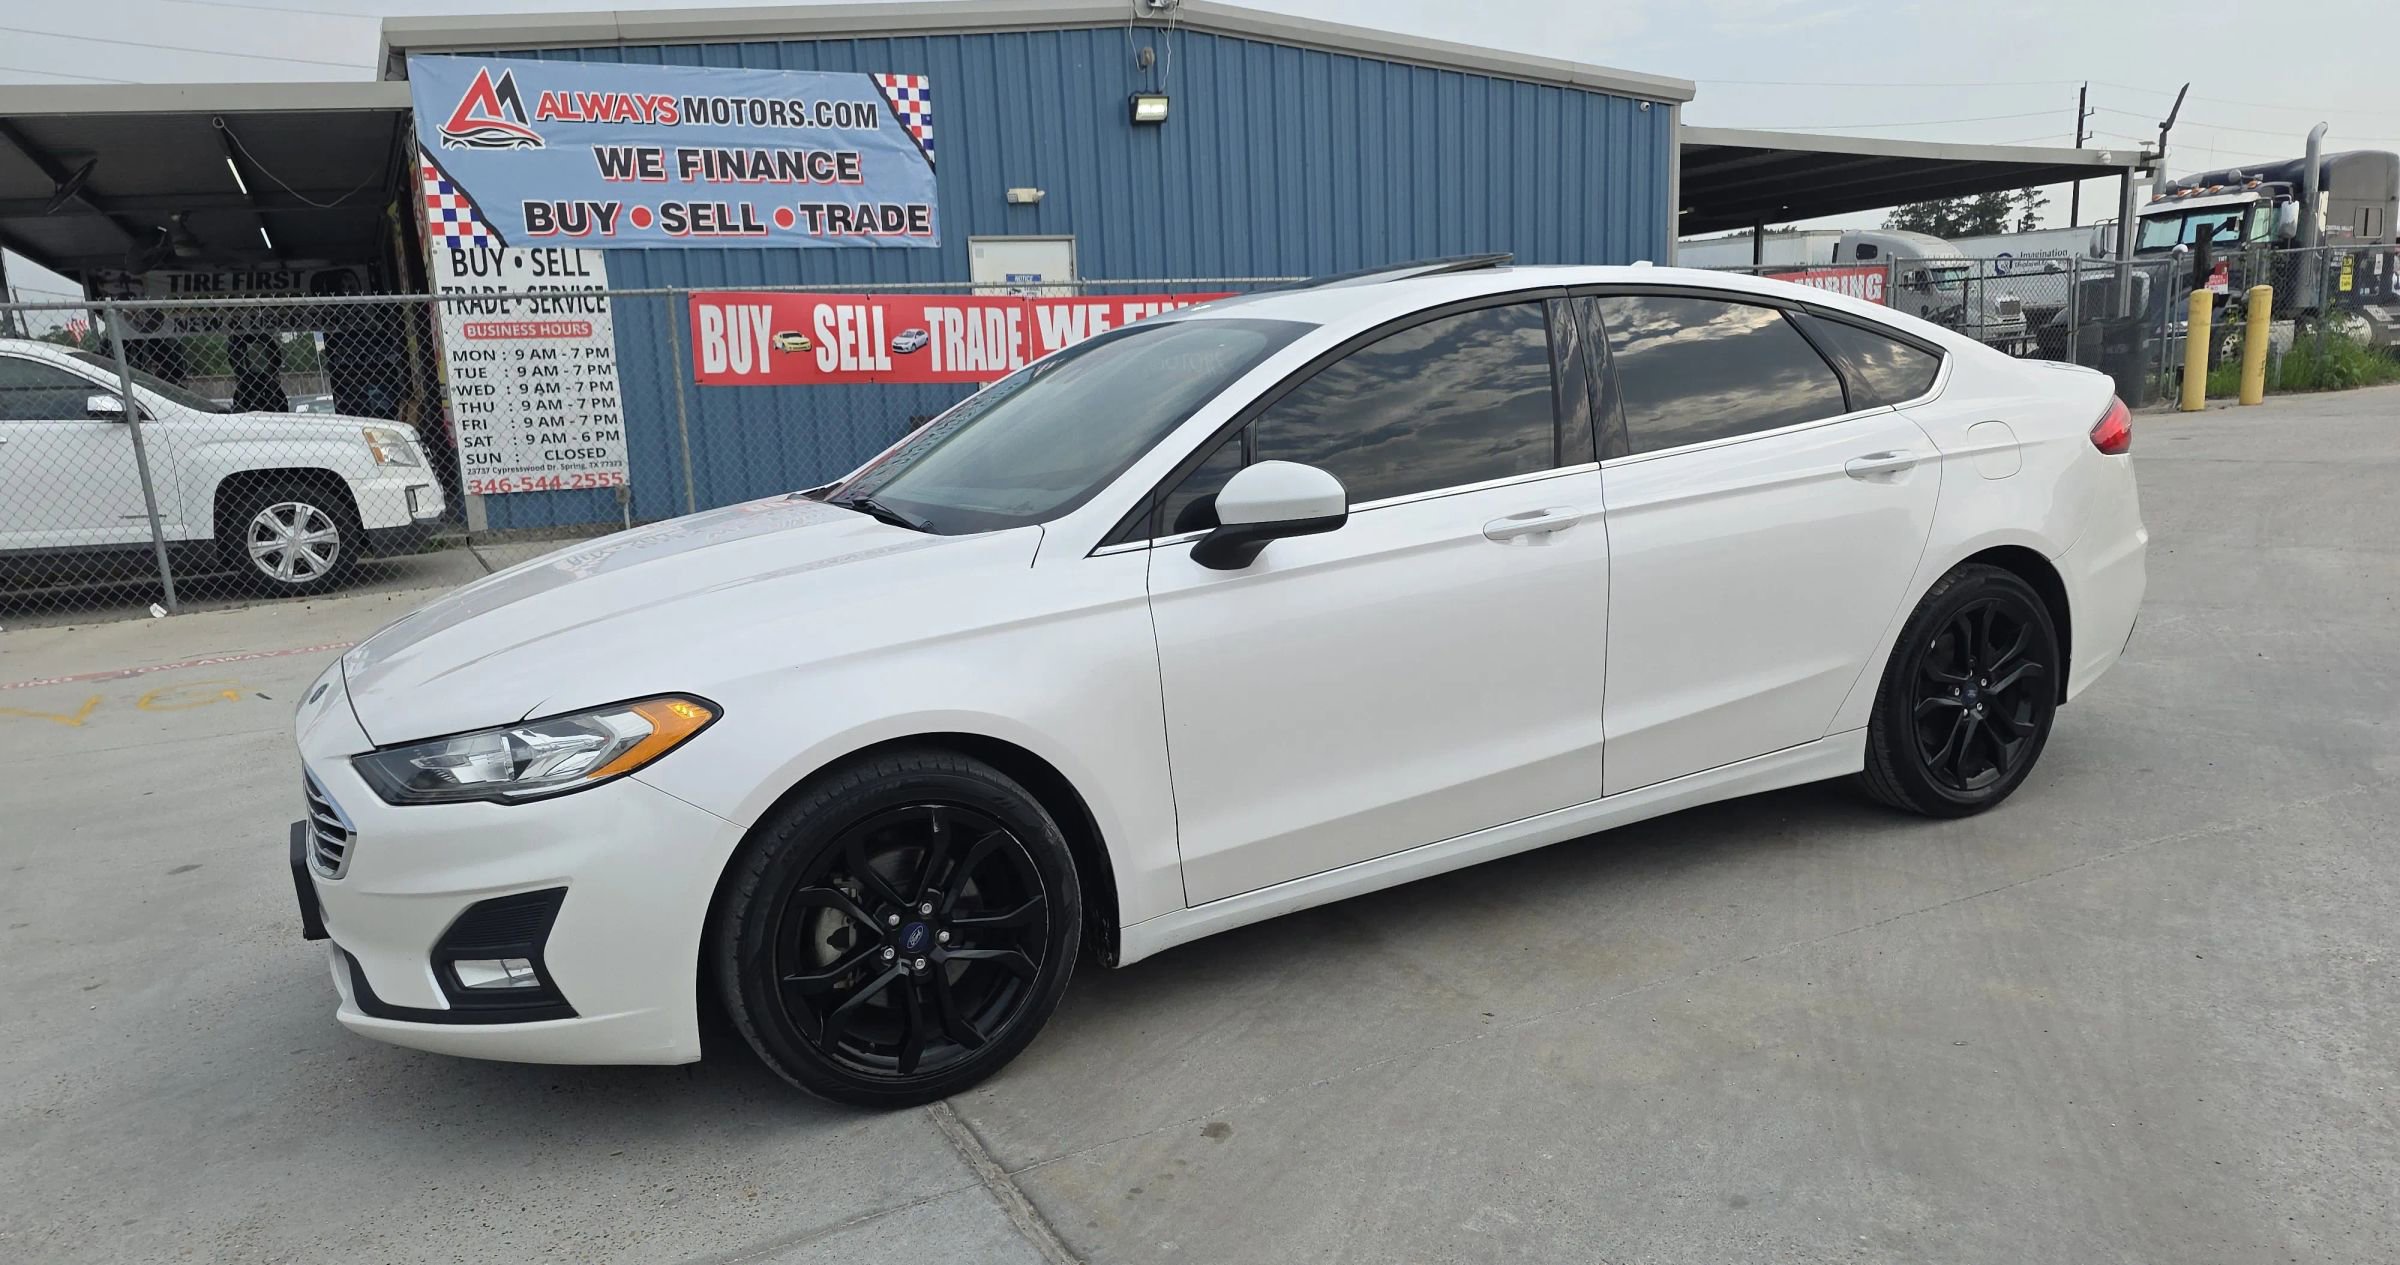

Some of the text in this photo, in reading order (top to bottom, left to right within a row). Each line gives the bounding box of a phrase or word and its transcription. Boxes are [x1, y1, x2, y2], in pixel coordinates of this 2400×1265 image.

[596, 147, 862, 184] WE FINANCE
[522, 201, 931, 237] BUY SELL TRADE
[451, 248, 590, 277] BUY SELL
[167, 271, 305, 292] TIRE FIRST
[441, 285, 607, 315] TRADE SERVICE
[173, 314, 224, 333] NEW
[467, 323, 589, 337] BUSINESS HOURS
[1036, 304, 1111, 350] WE
[699, 303, 1024, 374] BUY SELL TRADE
[453, 350, 496, 362] MON
[515, 350, 525, 360] 9
[530, 349, 557, 360] AM
[571, 348, 580, 359] 7
[585, 347, 610, 359] PM
[454, 367, 488, 379] TUE
[517, 366, 527, 377] 9
[531, 366, 559, 377] AM
[573, 365, 582, 376] 7
[588, 364, 612, 375] PM
[456, 384, 496, 396] WED
[519, 384, 529, 394] 9
[534, 382, 561, 394] AM
[575, 382, 584, 393] 7
[590, 381, 614, 392] PM
[458, 402, 495, 413] THU
[521, 400, 531, 411] 9
[536, 400, 563, 411] AM
[577, 398, 586, 409] 7
[592, 398, 616, 409] PM
[462, 419, 488, 431] FRI
[524, 417, 533, 428] 9
[538, 416, 565, 428] AM
[579, 415, 588, 426] 7
[594, 414, 618, 425] PM
[464, 436, 494, 448] SAT
[526, 434, 536, 445] 9
[540, 432, 567, 445] AM
[582, 432, 591, 442] 6
[596, 430, 620, 442] PM
[466, 452, 502, 465] SUN
[544, 448, 607, 461] CLOSED
[492, 464, 545, 475] Cypresswood
[470, 471, 624, 496] 346-544-2555
